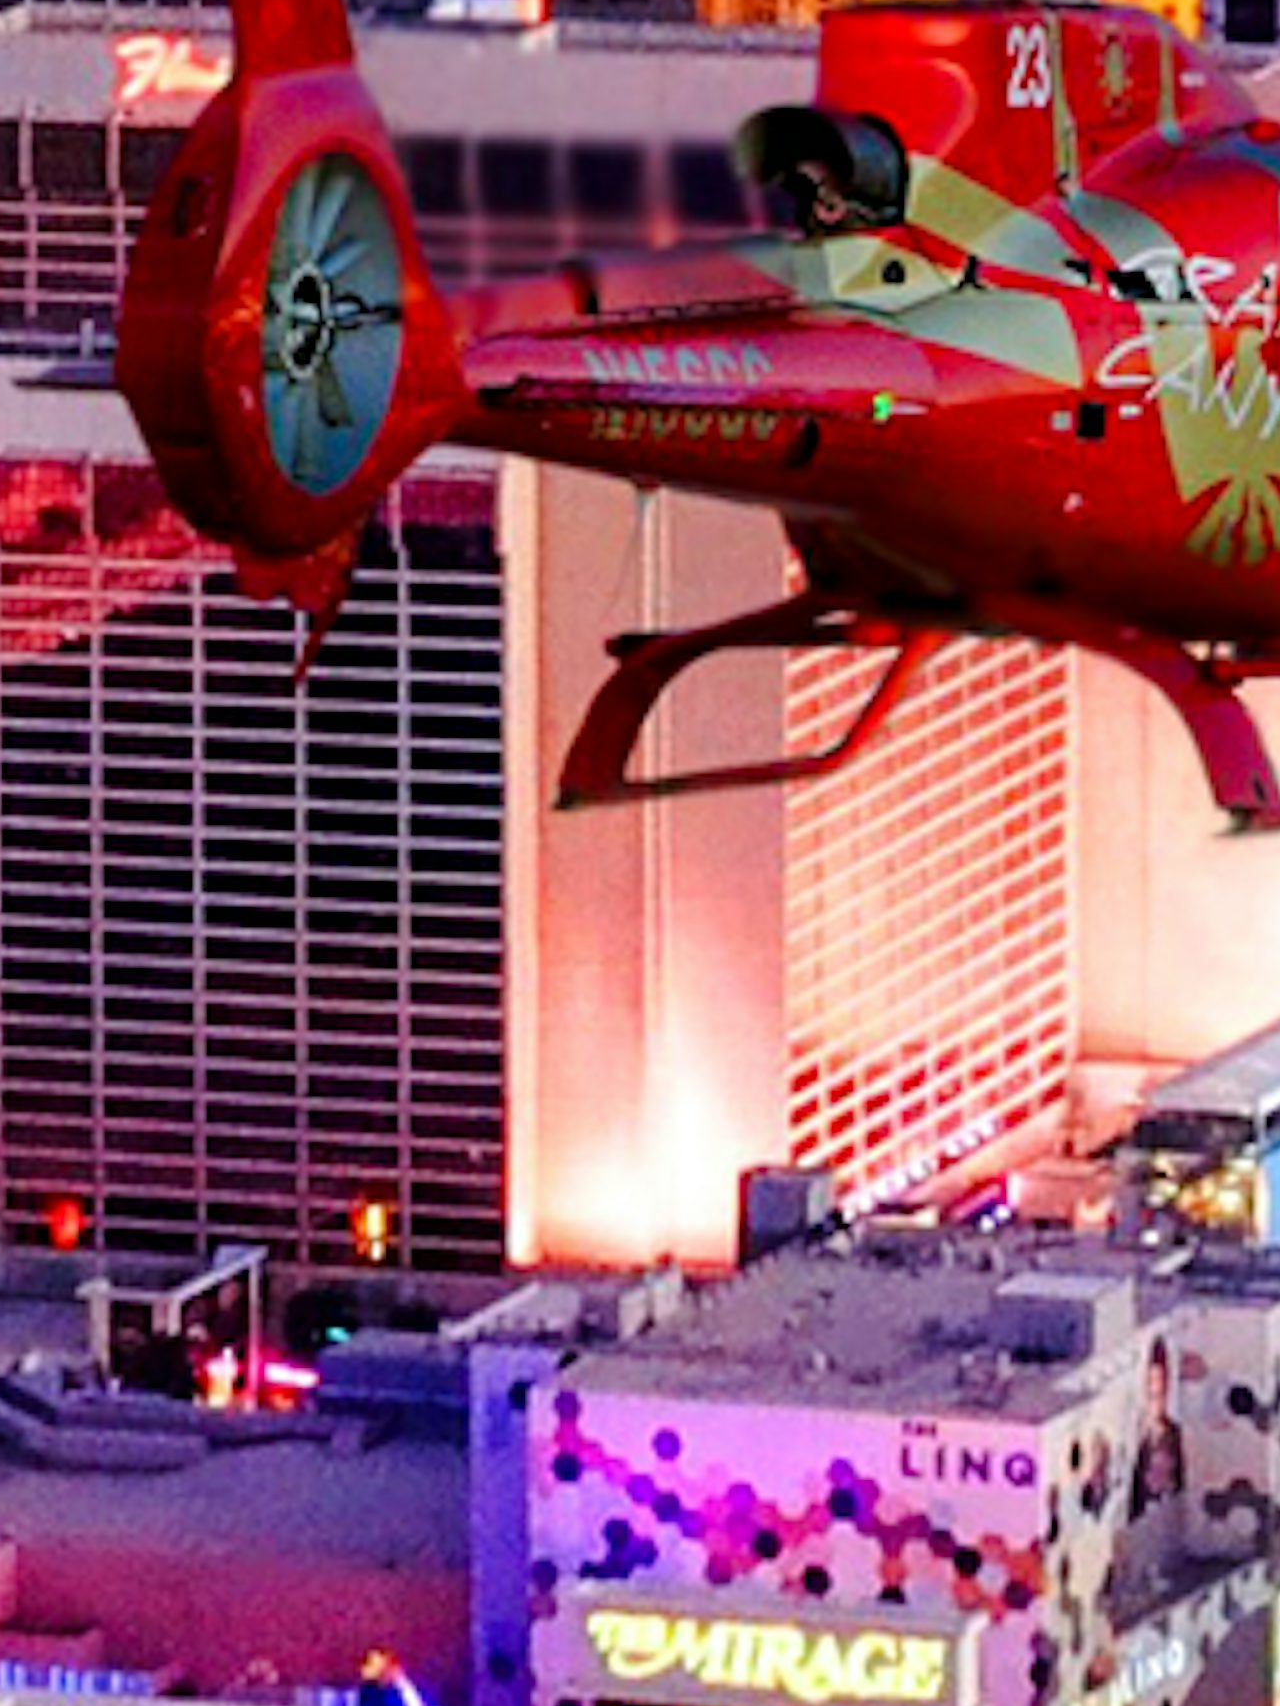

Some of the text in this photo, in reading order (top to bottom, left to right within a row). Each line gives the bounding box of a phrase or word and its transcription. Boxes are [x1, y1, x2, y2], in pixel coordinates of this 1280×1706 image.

[1007, 26, 1051, 107] 23
[902, 1445, 1036, 1487] LINQ
[670, 1618, 942, 1702] MIRAGE
